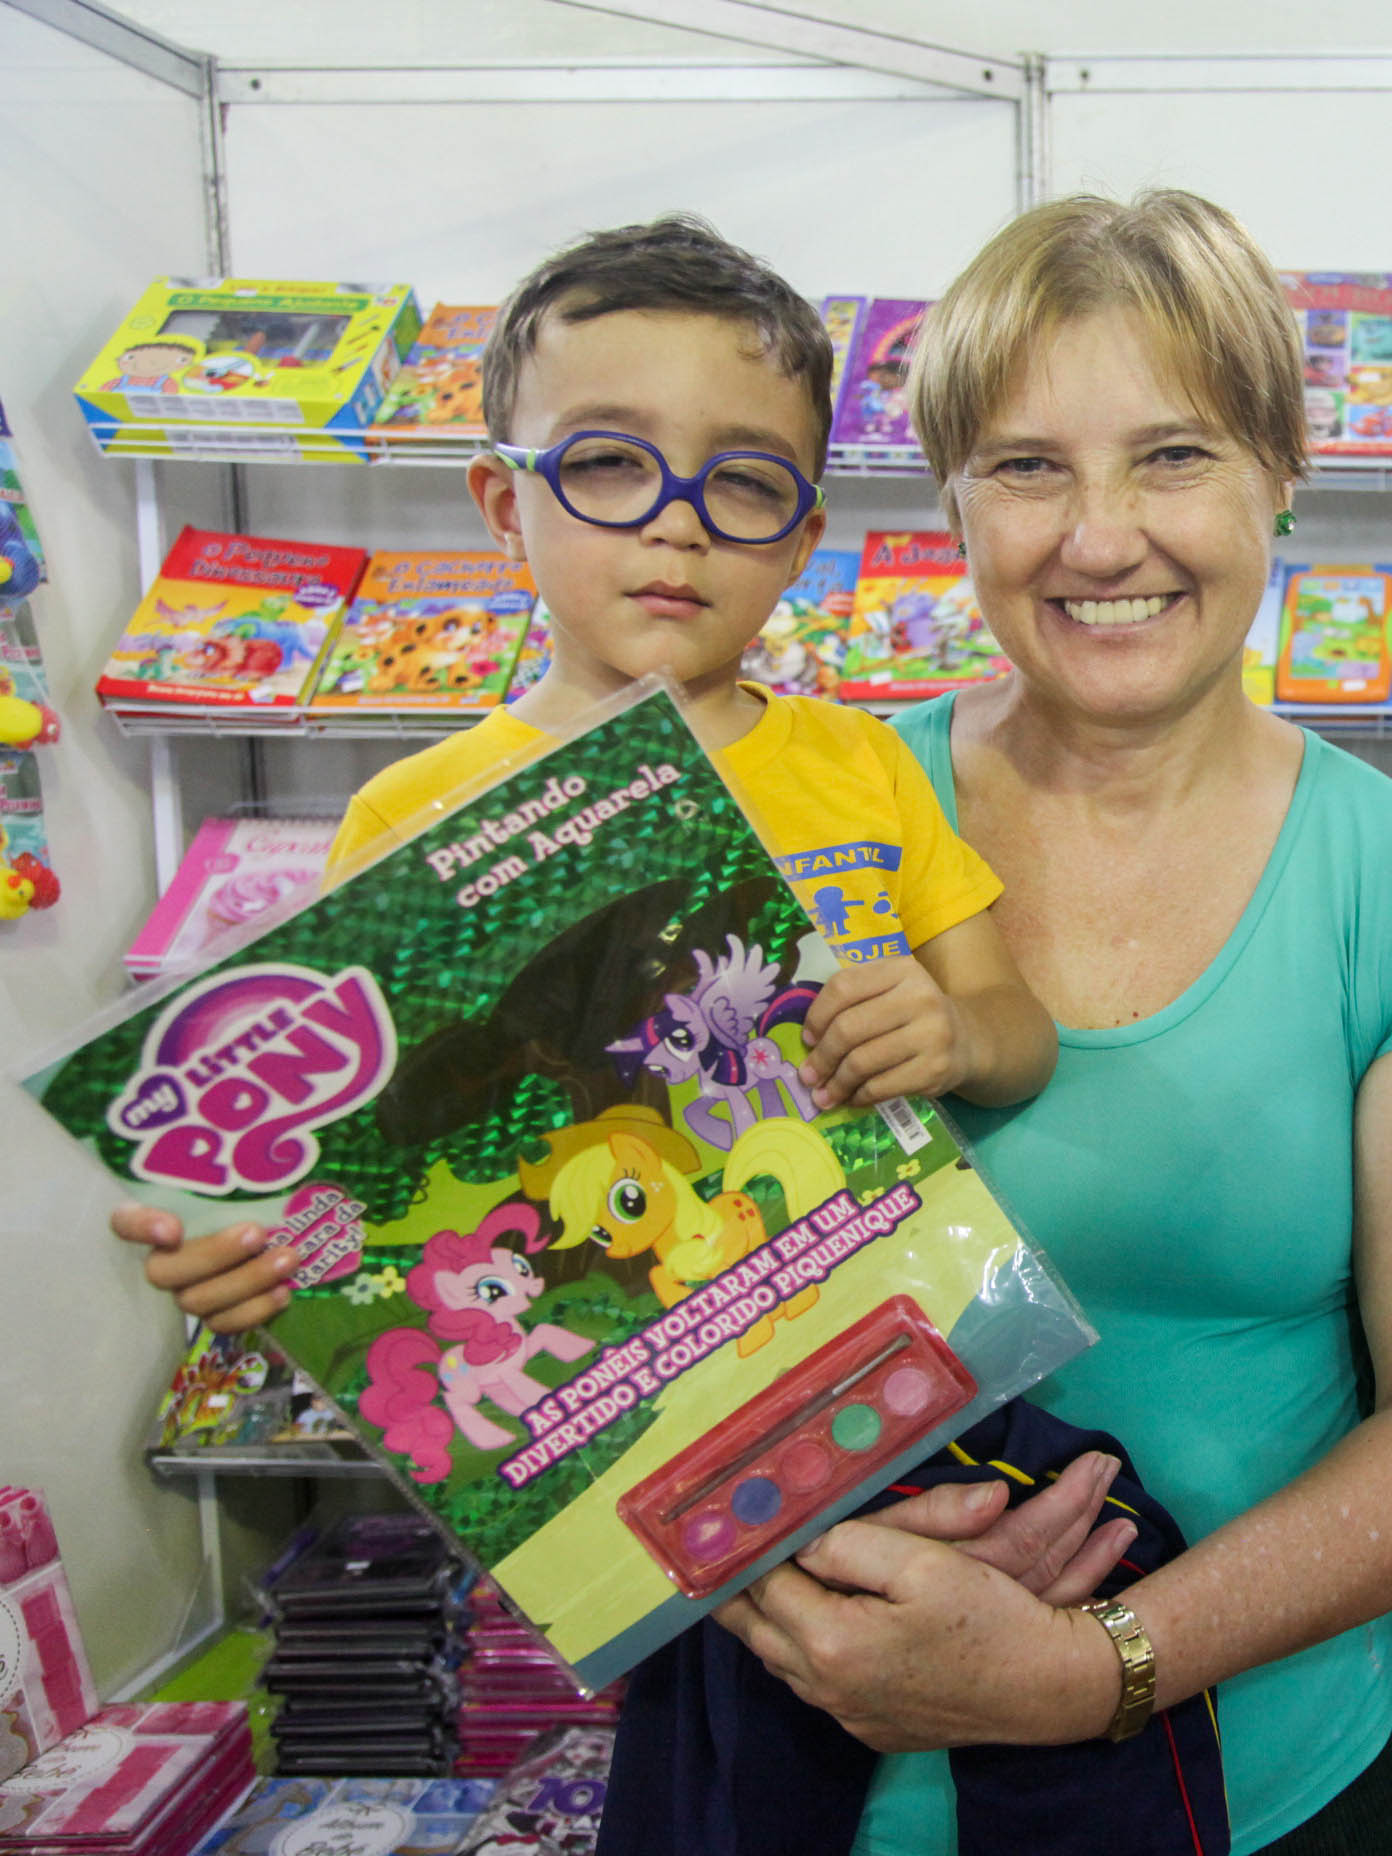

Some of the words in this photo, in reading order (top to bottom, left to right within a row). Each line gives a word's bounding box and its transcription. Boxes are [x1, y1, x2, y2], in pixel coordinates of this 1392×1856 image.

[427, 775, 586, 881] Pintando
[456, 855, 529, 907] com
[527, 763, 682, 862] Aquarela
[844, 940, 901, 962] OJE
[143, 975, 385, 1186] PONY
[284, 1192, 341, 1234] linda
[338, 1202, 362, 1223] da
[502, 1383, 636, 1486] DIVERTIDO
[630, 1366, 661, 1396] E
[654, 1283, 777, 1379] COLORIDO
[771, 1183, 917, 1298] PIQUENIQUE
[523, 1397, 564, 1437] AS
[558, 1337, 649, 1413] PONÊIS
[644, 1247, 781, 1350] VOLTARAM
[771, 1221, 820, 1262] EM
[811, 1192, 859, 1233] UM
